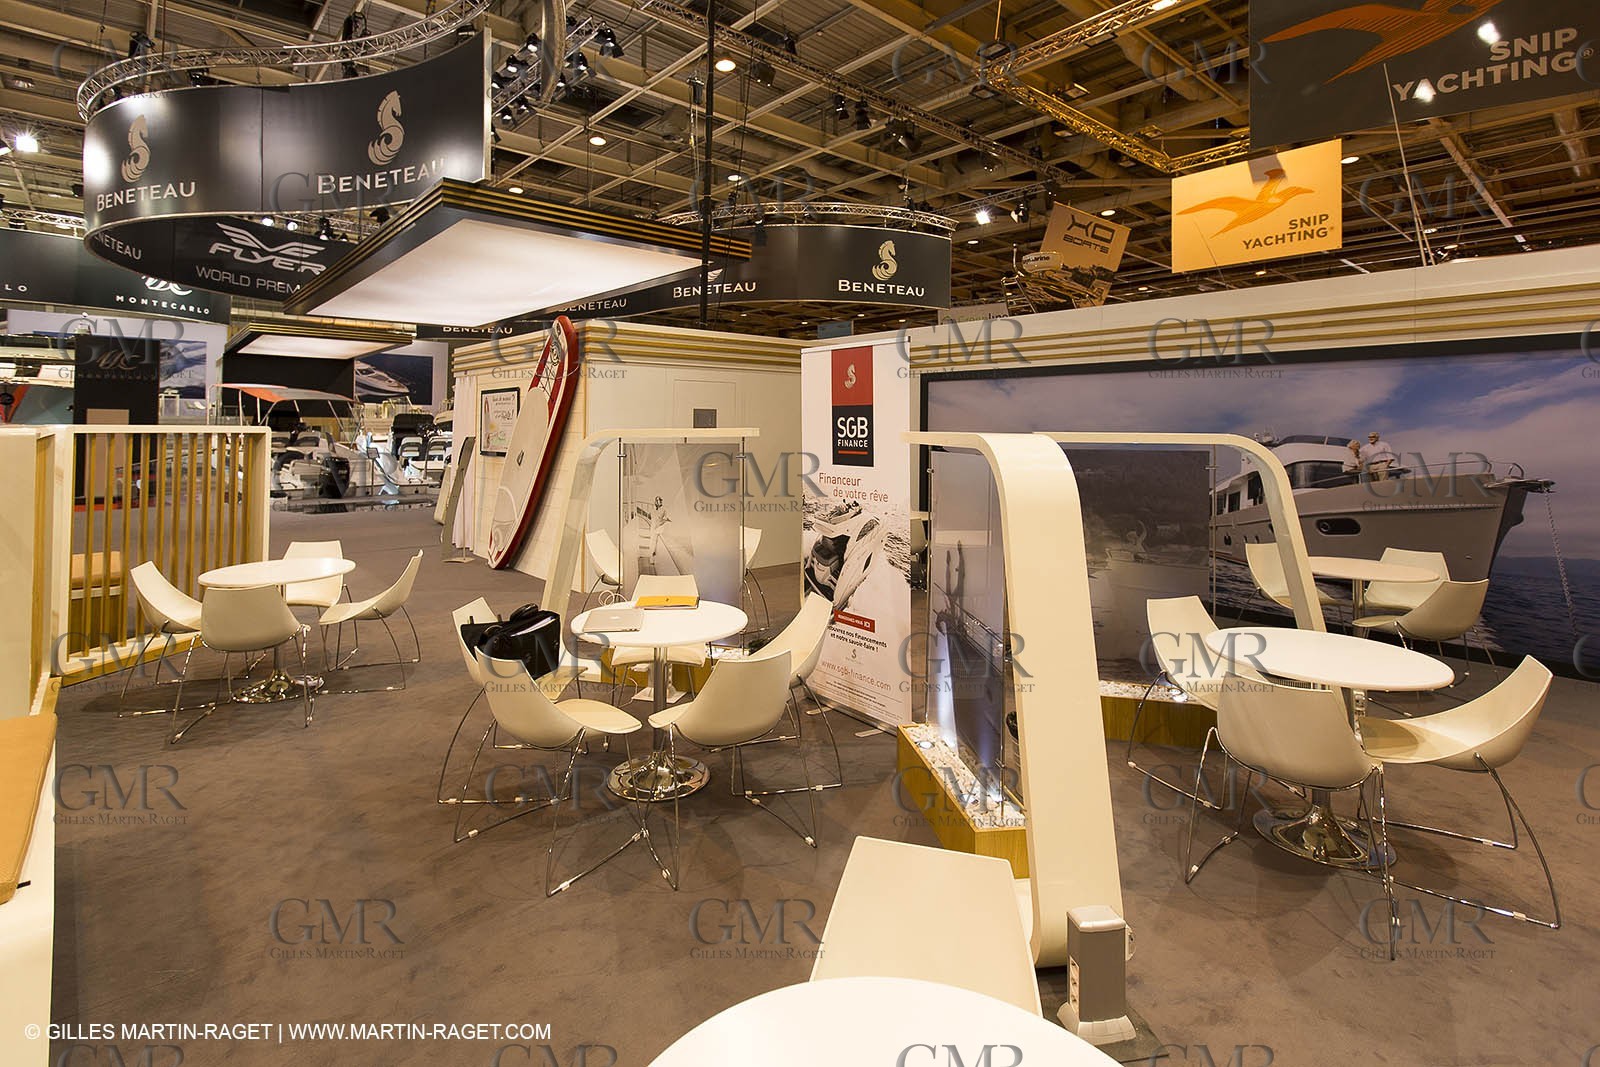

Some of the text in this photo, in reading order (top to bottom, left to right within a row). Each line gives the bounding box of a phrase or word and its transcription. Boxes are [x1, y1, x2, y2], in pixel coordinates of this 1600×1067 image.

[1489, 28, 1577, 61] SNIP
[317, 158, 446, 194] BENETEAU
[96, 181, 196, 212] BENETEAU
[1288, 213, 1329, 229] SNIP
[195, 265, 250, 287] WORLD
[673, 281, 757, 298] BENETEAU
[838, 279, 925, 297] BENETEAU
[115, 295, 210, 315] MONTECARLO
[837, 417, 869, 438] SGB
[837, 439, 868, 448] FINANCE
[818, 472, 861, 487] Financeur
[833, 487, 889, 502] de votre rêve
[821, 660, 892, 692] www.sgb-finance.com
